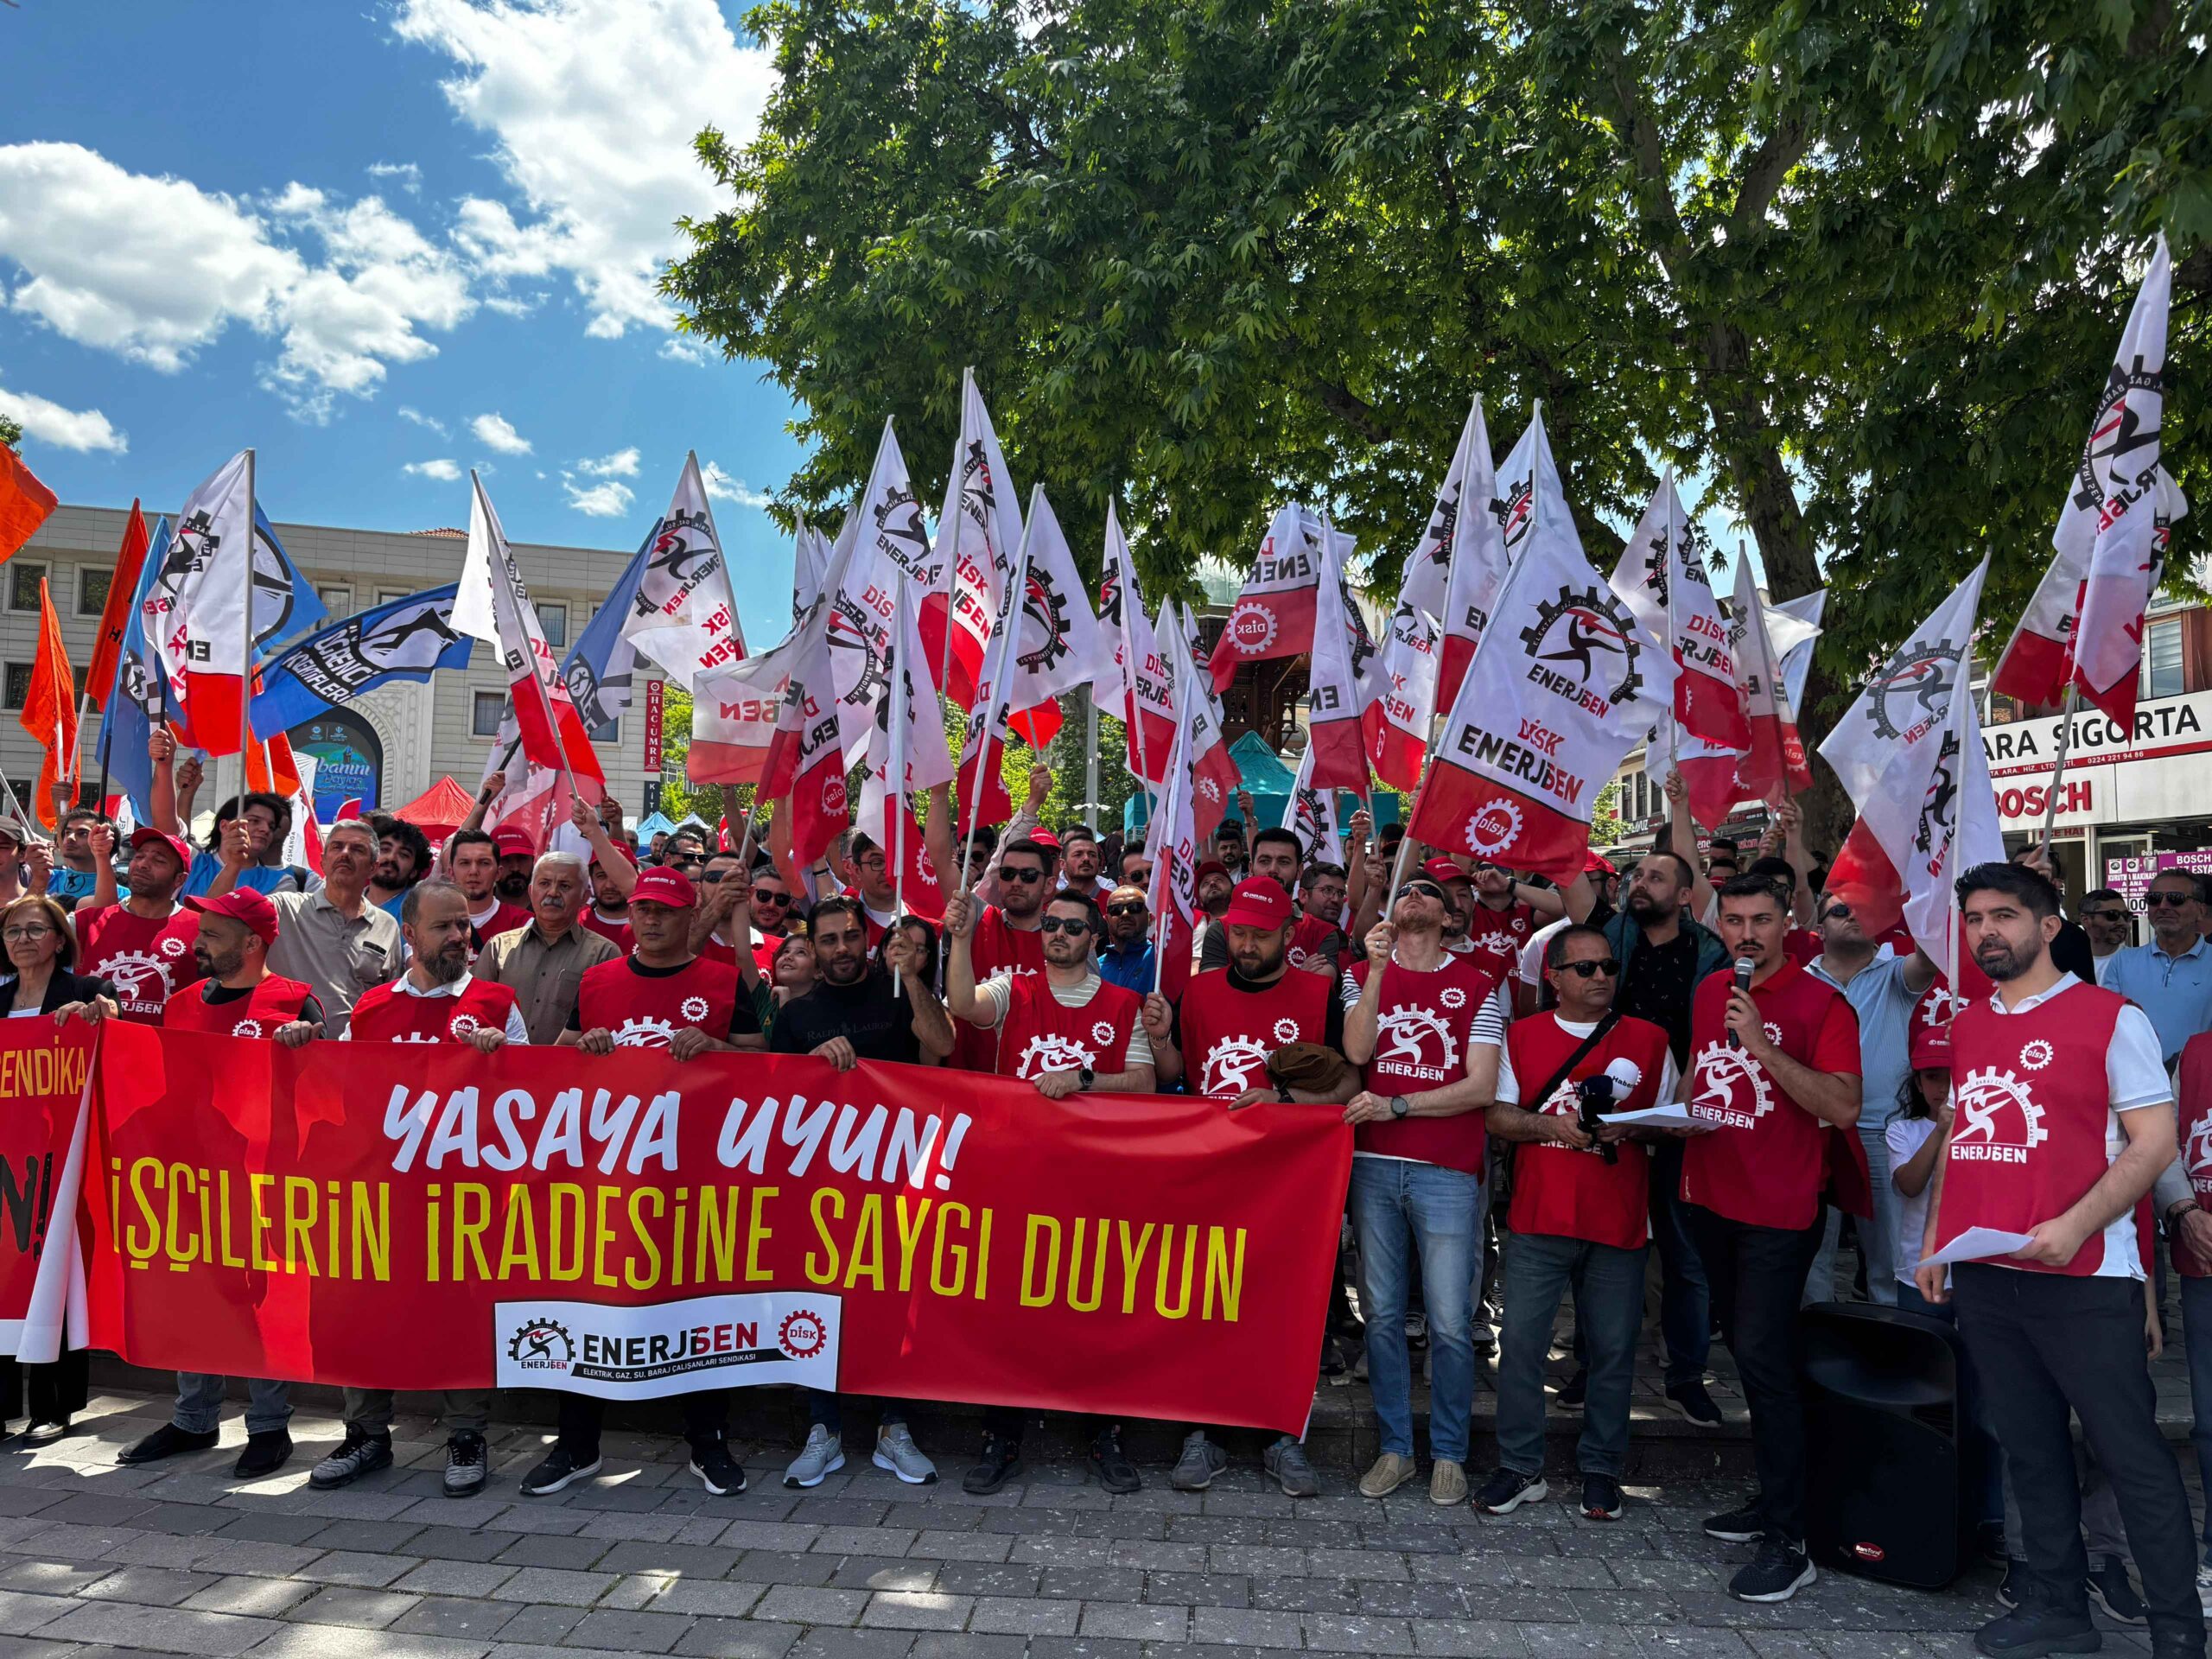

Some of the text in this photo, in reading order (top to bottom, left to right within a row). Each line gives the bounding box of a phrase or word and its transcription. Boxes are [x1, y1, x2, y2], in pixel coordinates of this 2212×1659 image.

[2088, 756, 2105, 765] 0224
[2107, 753, 2120, 762] 221
[1478, 817, 1508, 837] DİSK
[2177, 855, 2211, 865] BOSCH
[0, 1036, 85, 1098] ENDİKA
[383, 1084, 972, 1191] YASAYA UYUN!
[111, 1156, 391, 1281] İŞÇİLERİN
[427, 1182, 779, 1290] İRADESİNE
[804, 1187, 993, 1300] SAYGI
[1020, 1213, 1247, 1322] DUYUN
[789, 1325, 817, 1341] DİSK
[583, 1368, 614, 1379] ELEKTRİK,
[615, 1371, 632, 1380] GAZ,
[648, 1366, 671, 1377] BARAJ
[672, 1357, 717, 1372] ÇALIŞANLARI
[718, 1353, 756, 1364] SENDİKASI
